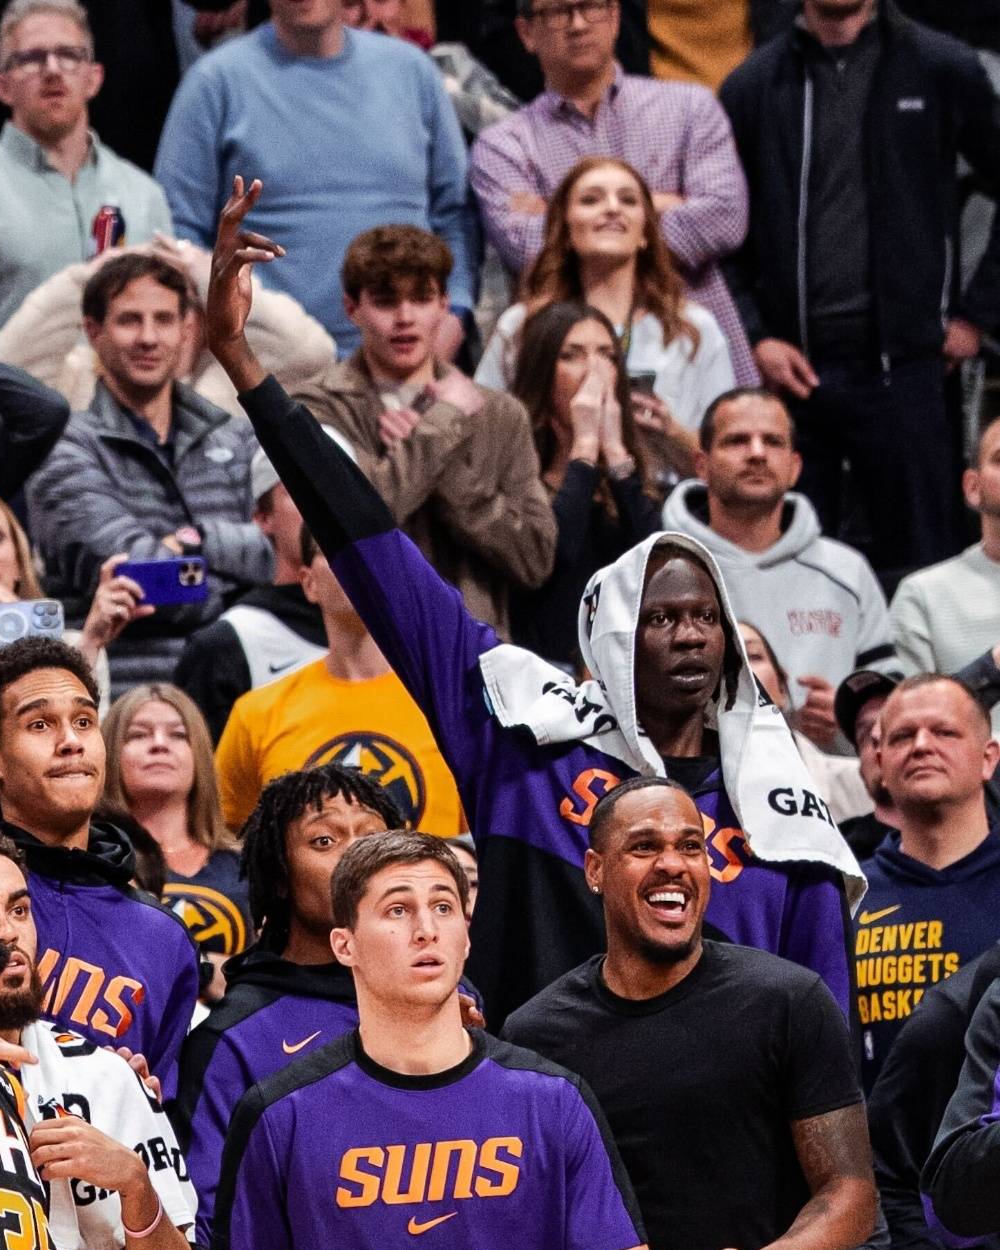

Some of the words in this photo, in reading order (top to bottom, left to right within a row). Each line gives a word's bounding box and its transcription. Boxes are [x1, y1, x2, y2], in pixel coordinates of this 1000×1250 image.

[855, 920, 943, 956] DENVER
[856, 952, 960, 988] NUGGETS
[336, 1137, 523, 1208] SUNS
